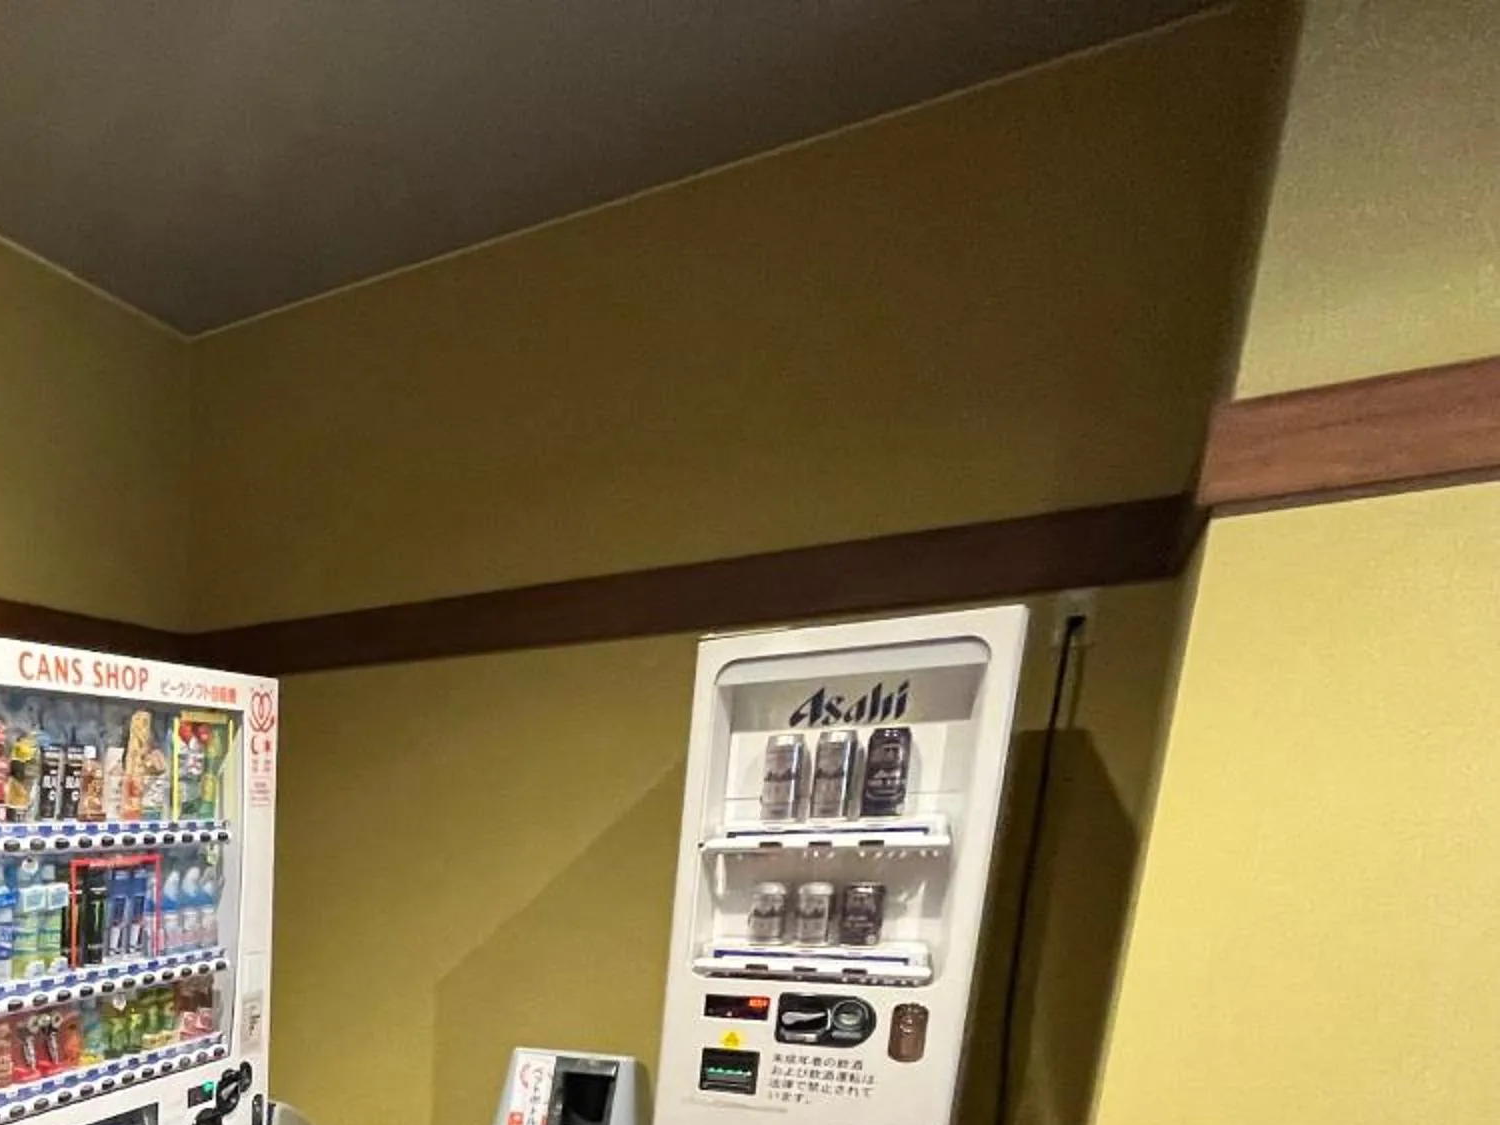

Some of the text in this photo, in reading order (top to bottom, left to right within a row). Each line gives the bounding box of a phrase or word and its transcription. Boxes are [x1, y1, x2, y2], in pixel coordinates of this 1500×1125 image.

[18, 650, 150, 693] CANS SHOP
[789, 680, 910, 728] Asahi
